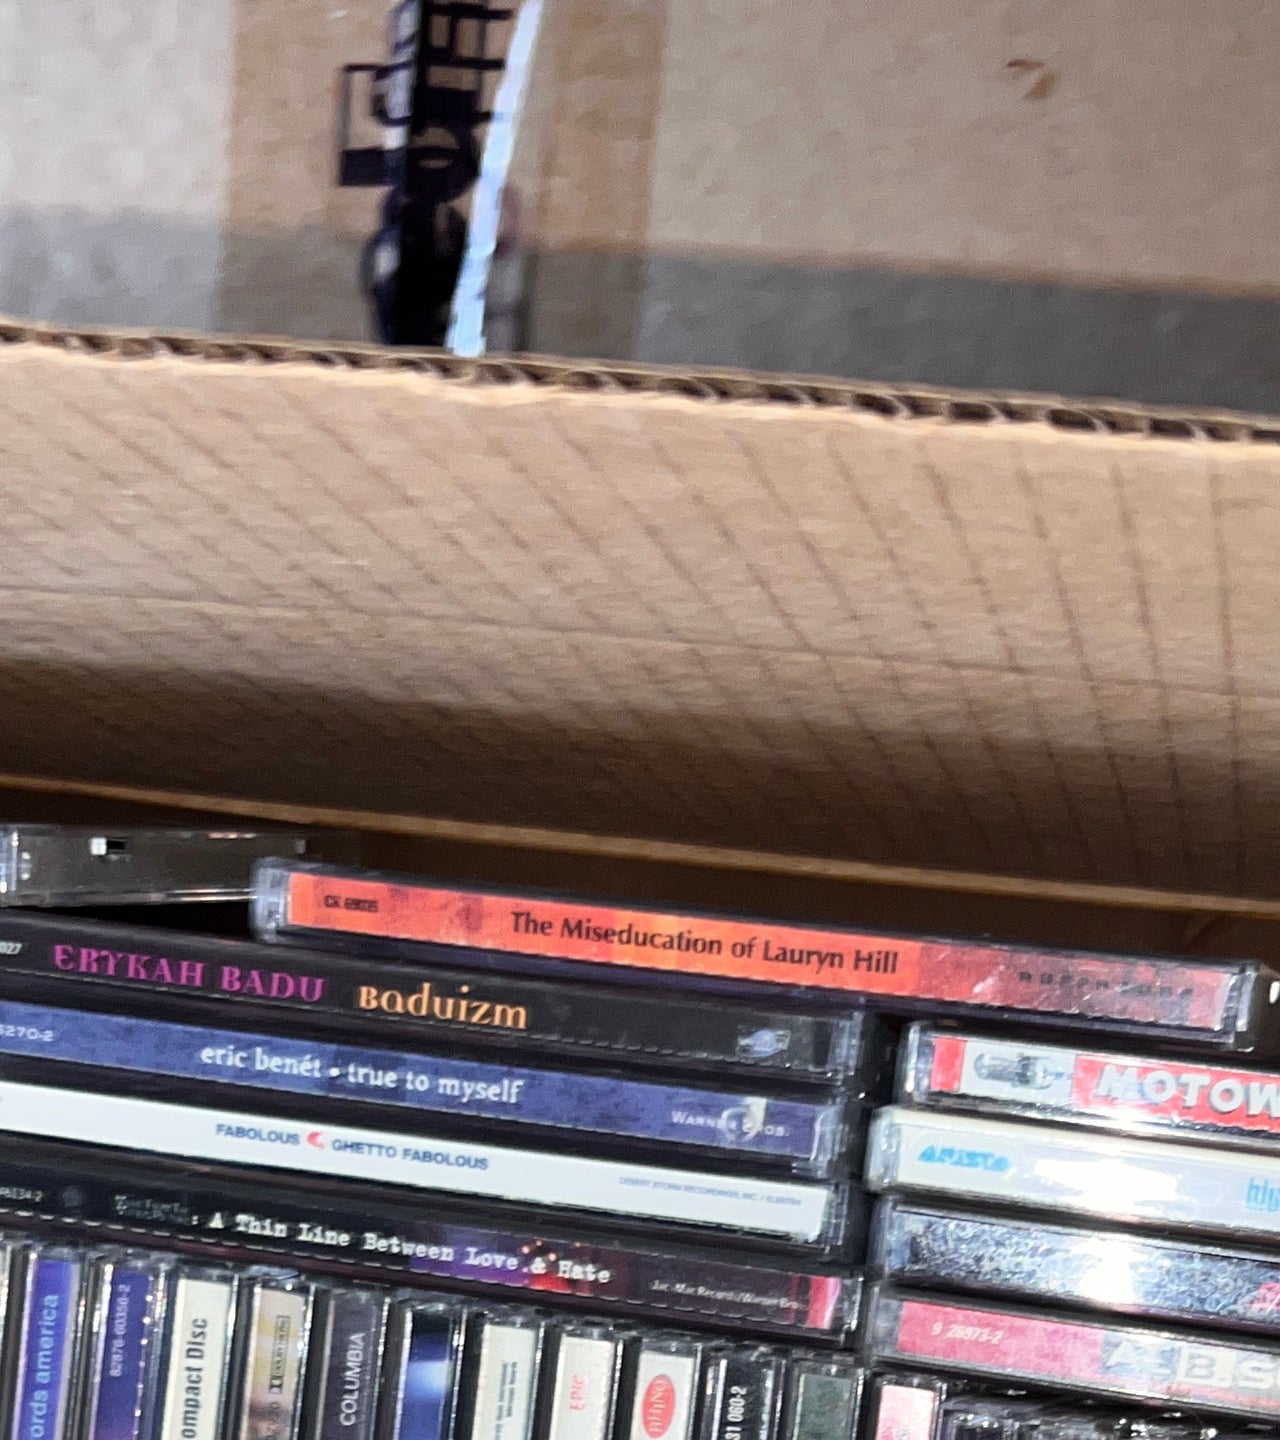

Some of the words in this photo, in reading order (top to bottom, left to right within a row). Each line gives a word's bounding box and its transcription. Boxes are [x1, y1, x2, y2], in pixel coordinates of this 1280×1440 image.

[510, 911, 553, 936] The
[559, 917, 722, 954] Miseducation
[730, 935, 757, 958] of
[761, 939, 844, 974] Lauryn
[853, 948, 898, 974] Hill
[220, 965, 326, 1002] BADU
[199, 1044, 248, 1068] eric
[347, 1064, 398, 1088] true
[405, 1070, 428, 1091] to
[437, 1074, 524, 1106] myself
[215, 1123, 300, 1146] FABOLOUS
[331, 1139, 397, 1158] GHETTO
[402, 1147, 488, 1171] FABOLOUS
[234, 1214, 287, 1238] Thin
[296, 1223, 351, 1247] Line
[362, 1232, 455, 1261] Between
[465, 1247, 519, 1270] Love
[556, 1259, 610, 1283] Hate
[185, 1317, 209, 1359] Disc
[339, 1331, 366, 1426] COLUMBIA
[568, 1374, 588, 1411] EPIC
[726, 1385, 747, 1422] 060-2
